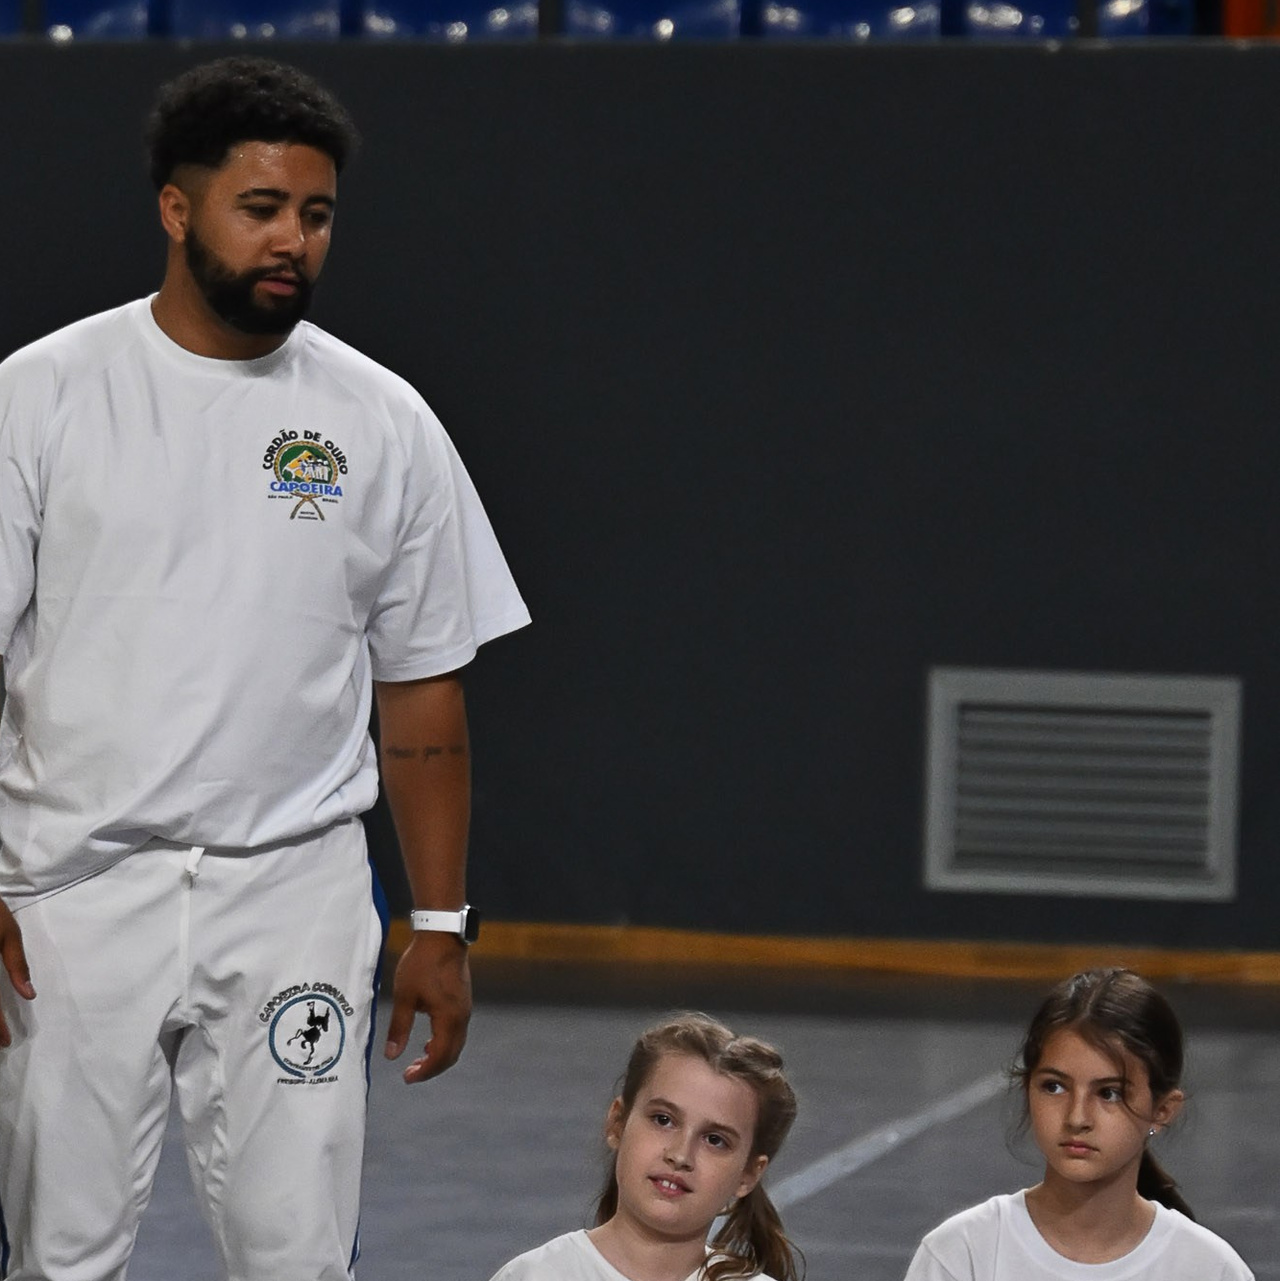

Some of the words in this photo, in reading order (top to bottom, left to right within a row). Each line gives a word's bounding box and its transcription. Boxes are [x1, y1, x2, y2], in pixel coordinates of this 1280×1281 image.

[262, 429, 298, 470] CORDÃO
[303, 430, 322, 442] DE
[324, 440, 348, 475] OURO
[270, 481, 343, 497] CAPOEIRA
